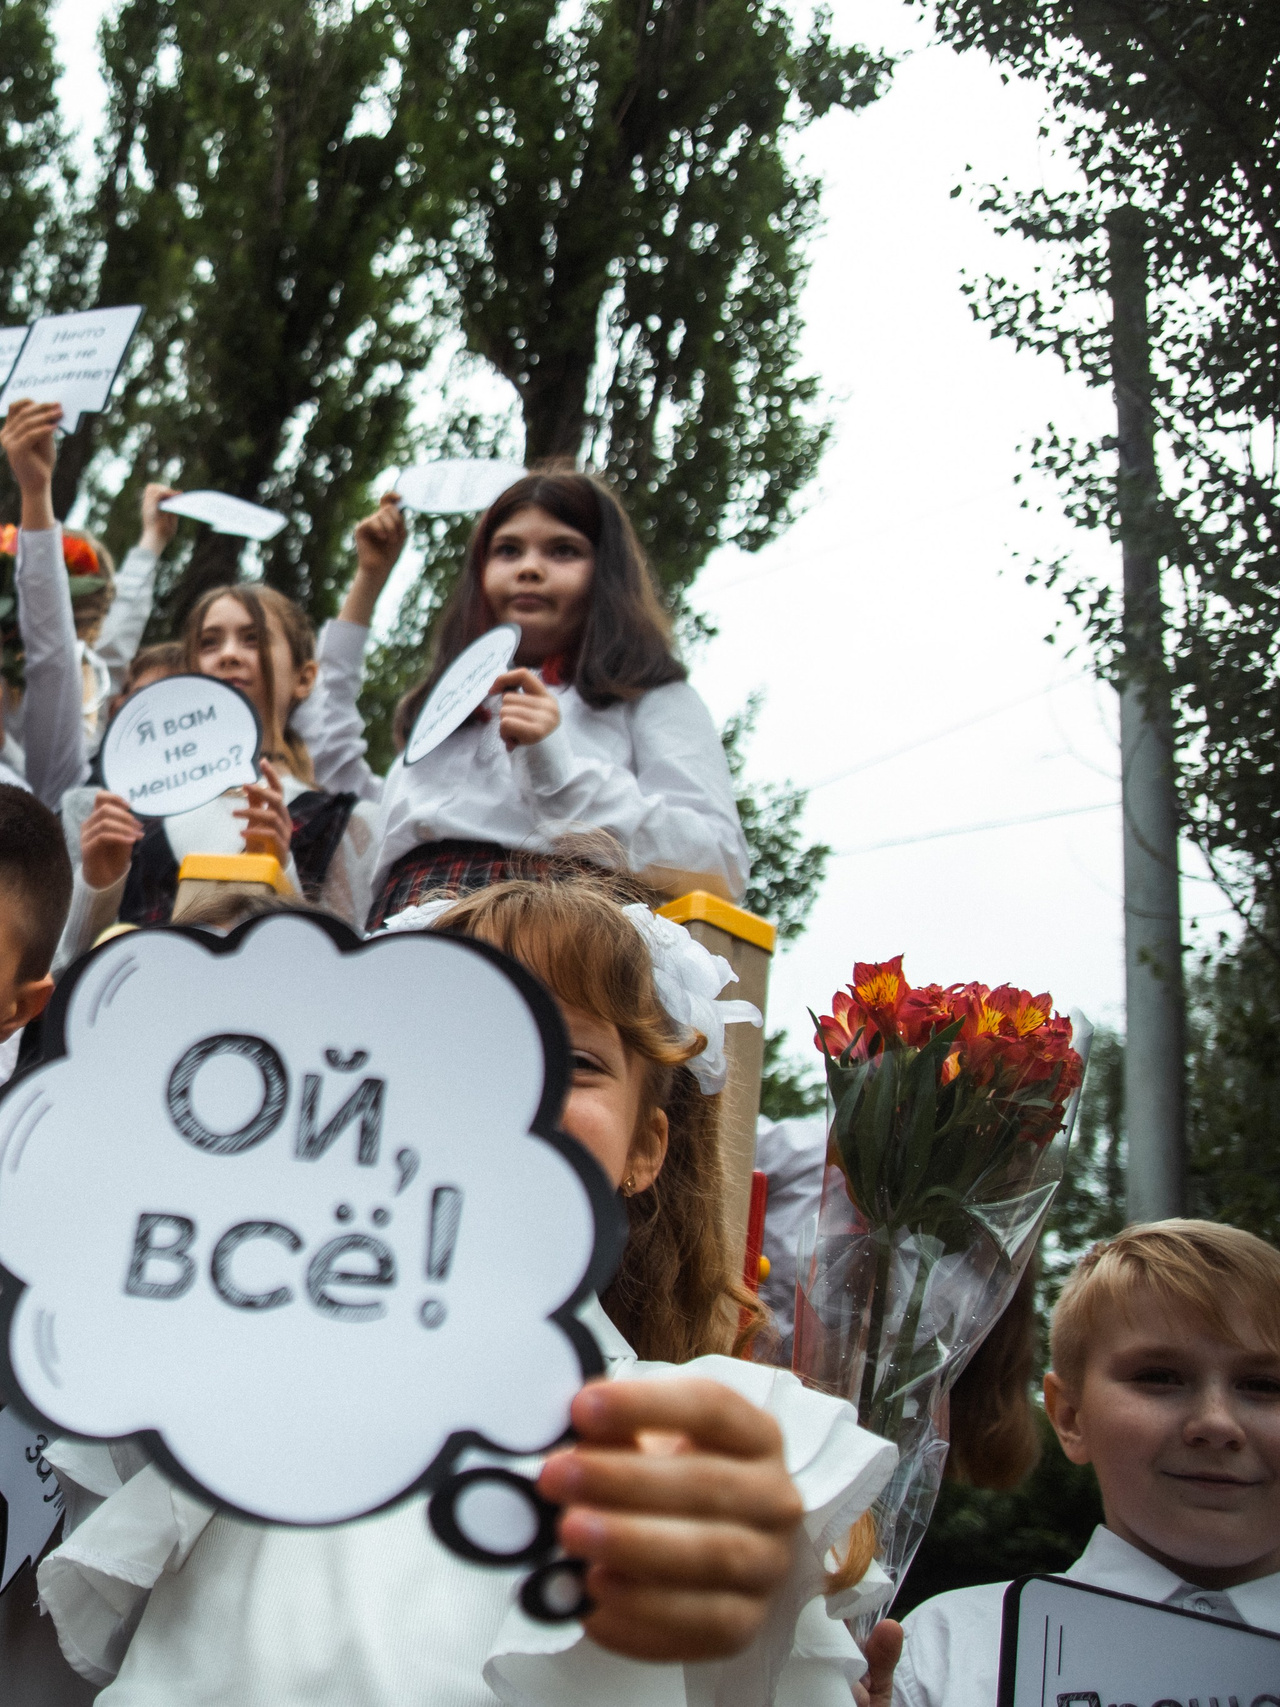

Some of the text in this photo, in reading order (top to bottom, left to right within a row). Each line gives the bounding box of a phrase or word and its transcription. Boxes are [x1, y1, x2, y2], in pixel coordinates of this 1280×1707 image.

[52, 326, 106, 344] Ничто
[136, 705, 217, 746] Я вам
[128, 744, 243, 800] мешаю?
[164, 742, 197, 764] не
[166, 1032, 420, 1196] Ой,
[123, 1182, 464, 1331] всё!
